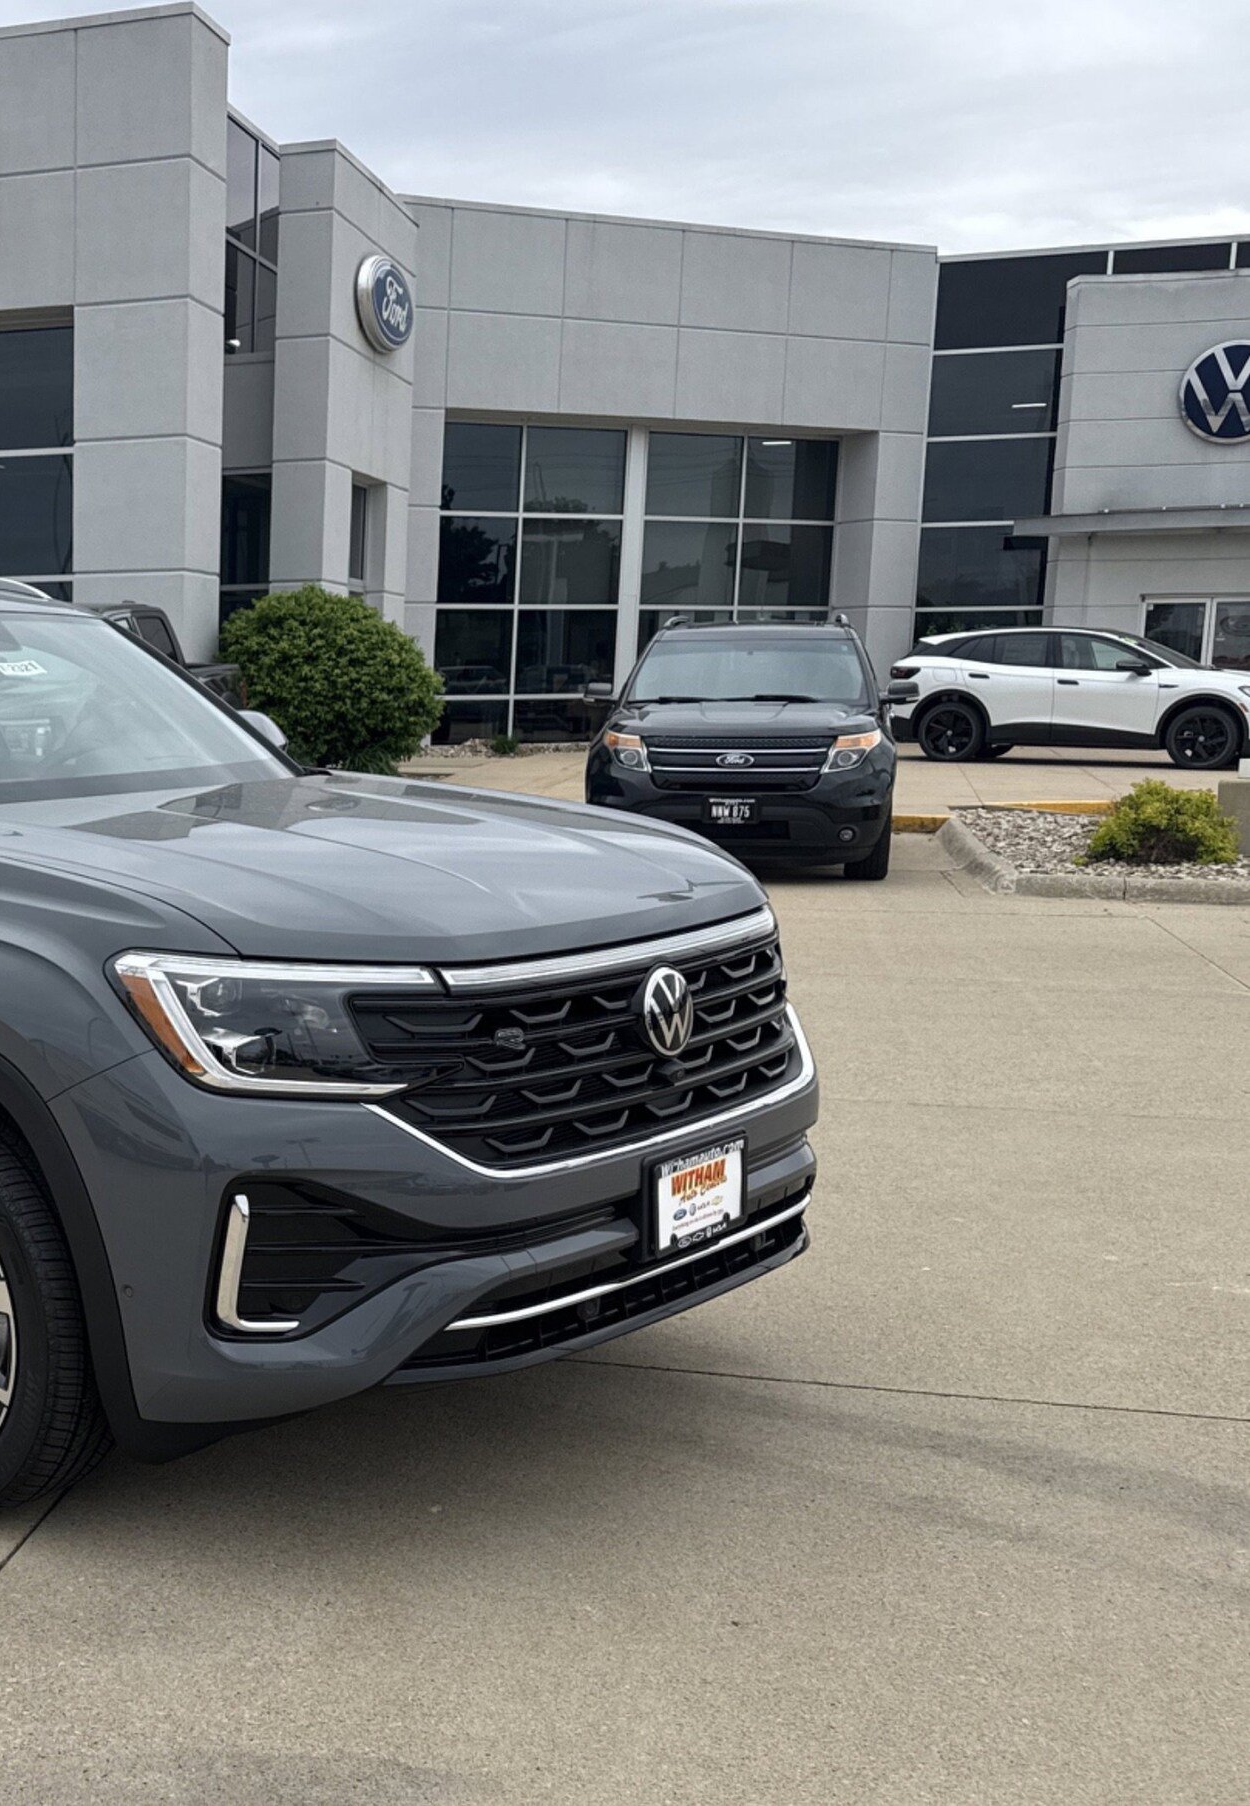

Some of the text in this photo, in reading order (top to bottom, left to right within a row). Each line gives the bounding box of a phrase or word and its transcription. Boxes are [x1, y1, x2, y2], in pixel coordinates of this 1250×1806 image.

[381, 276, 410, 333] Ford
[732, 805, 750, 818] 875
[671, 1159, 726, 1197] WITHAM
